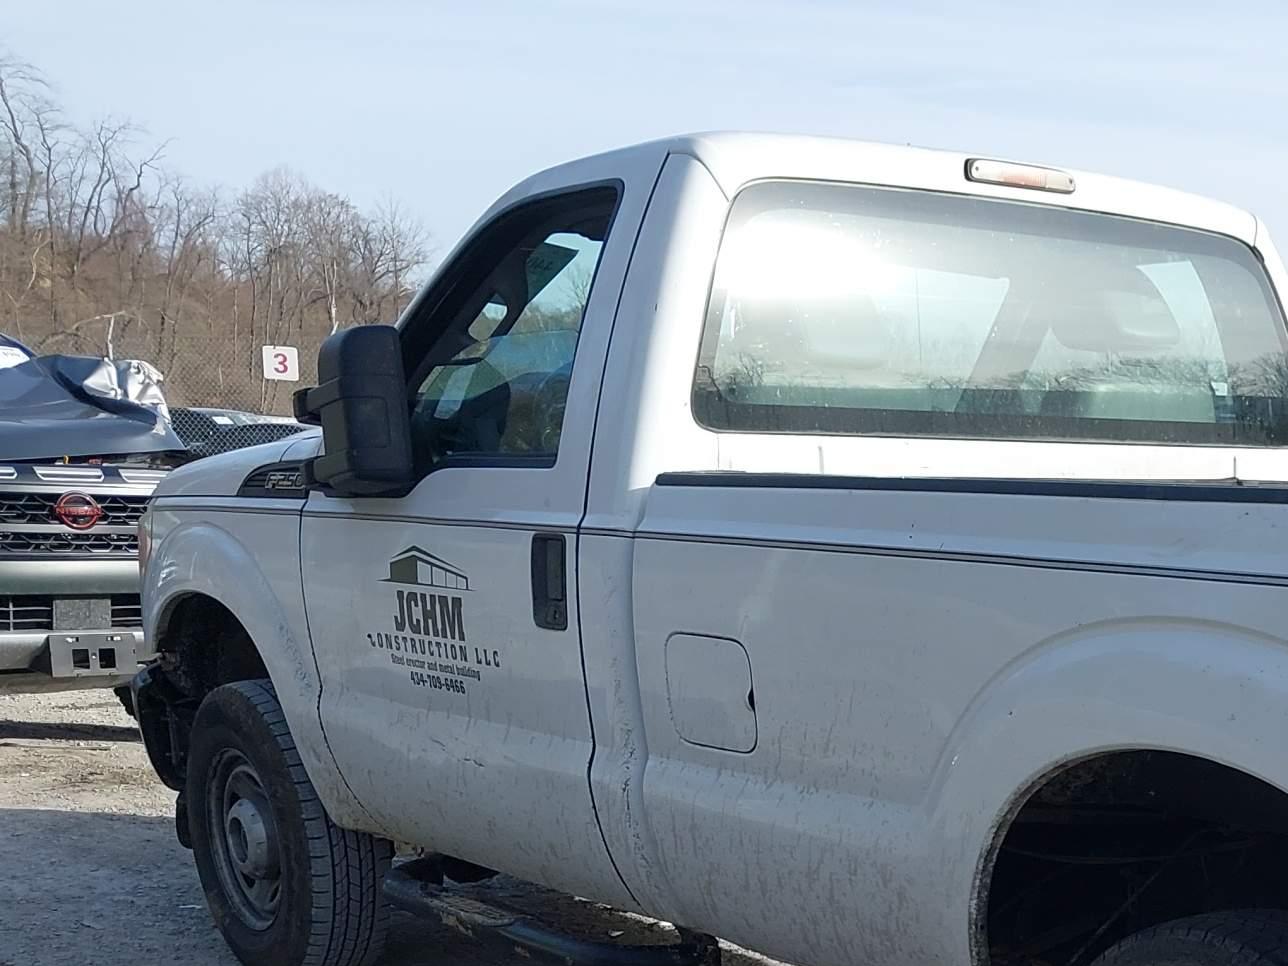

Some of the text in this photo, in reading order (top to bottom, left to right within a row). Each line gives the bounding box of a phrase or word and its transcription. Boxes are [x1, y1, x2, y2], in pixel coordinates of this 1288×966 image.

[273, 352, 289, 374] 3
[394, 590, 466, 642] JCHM
[390, 653, 481, 682] Steel erector and metal building
[475, 647, 501, 668] LLC
[410, 671, 466, 694] 434-709-6466
